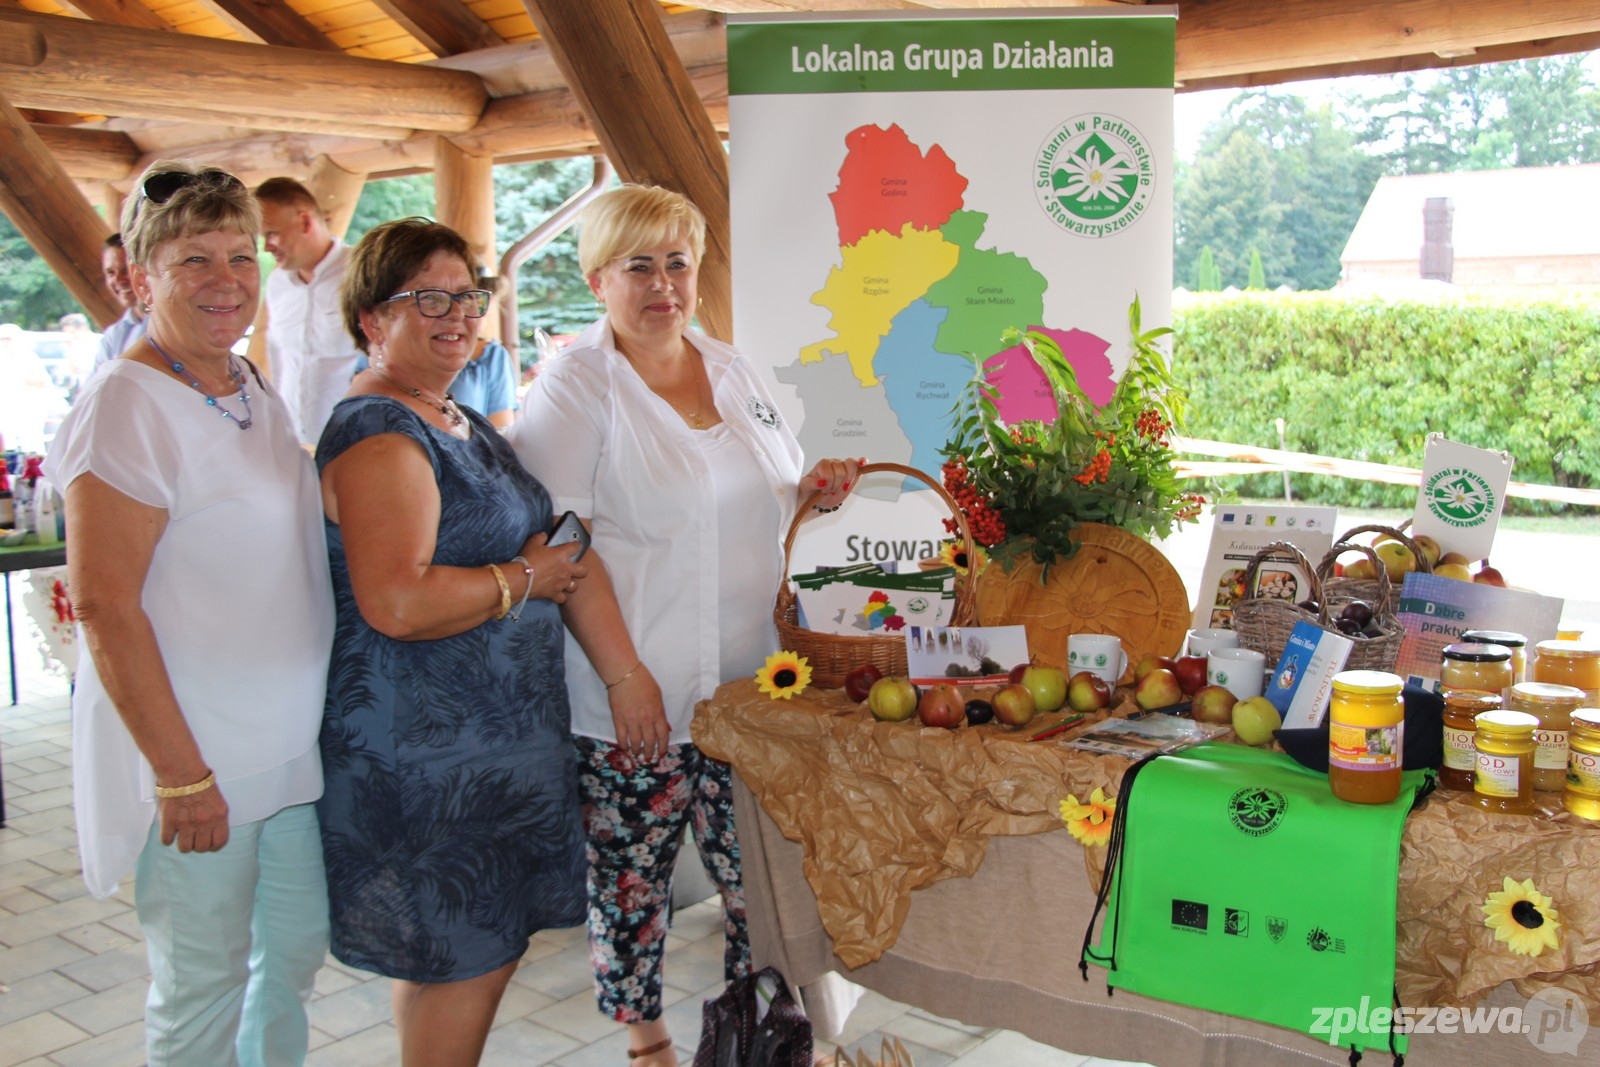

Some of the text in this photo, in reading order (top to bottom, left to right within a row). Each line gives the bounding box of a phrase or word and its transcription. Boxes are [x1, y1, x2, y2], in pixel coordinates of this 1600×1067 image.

[791, 40, 1114, 78] Lokalna Grupa Działania
[1037, 116, 1153, 188] Solidarni w Partnerstwie
[881, 178, 907, 186] Gmina
[881, 188, 907, 197] Golina
[1046, 201, 1144, 239] Stowarzyszenie
[863, 276, 889, 285] Gmina
[863, 286, 890, 296] Rzgów
[977, 286, 1003, 294] Gmina
[966, 297, 1015, 305] Stare Miasto
[919, 380, 945, 389] Gmina
[916, 390, 950, 400] Rychwał
[837, 418, 863, 427] Gmina
[832, 428, 868, 437] Grodziec
[1425, 602, 1465, 620] Dobre
[1421, 622, 1476, 640] prakty
